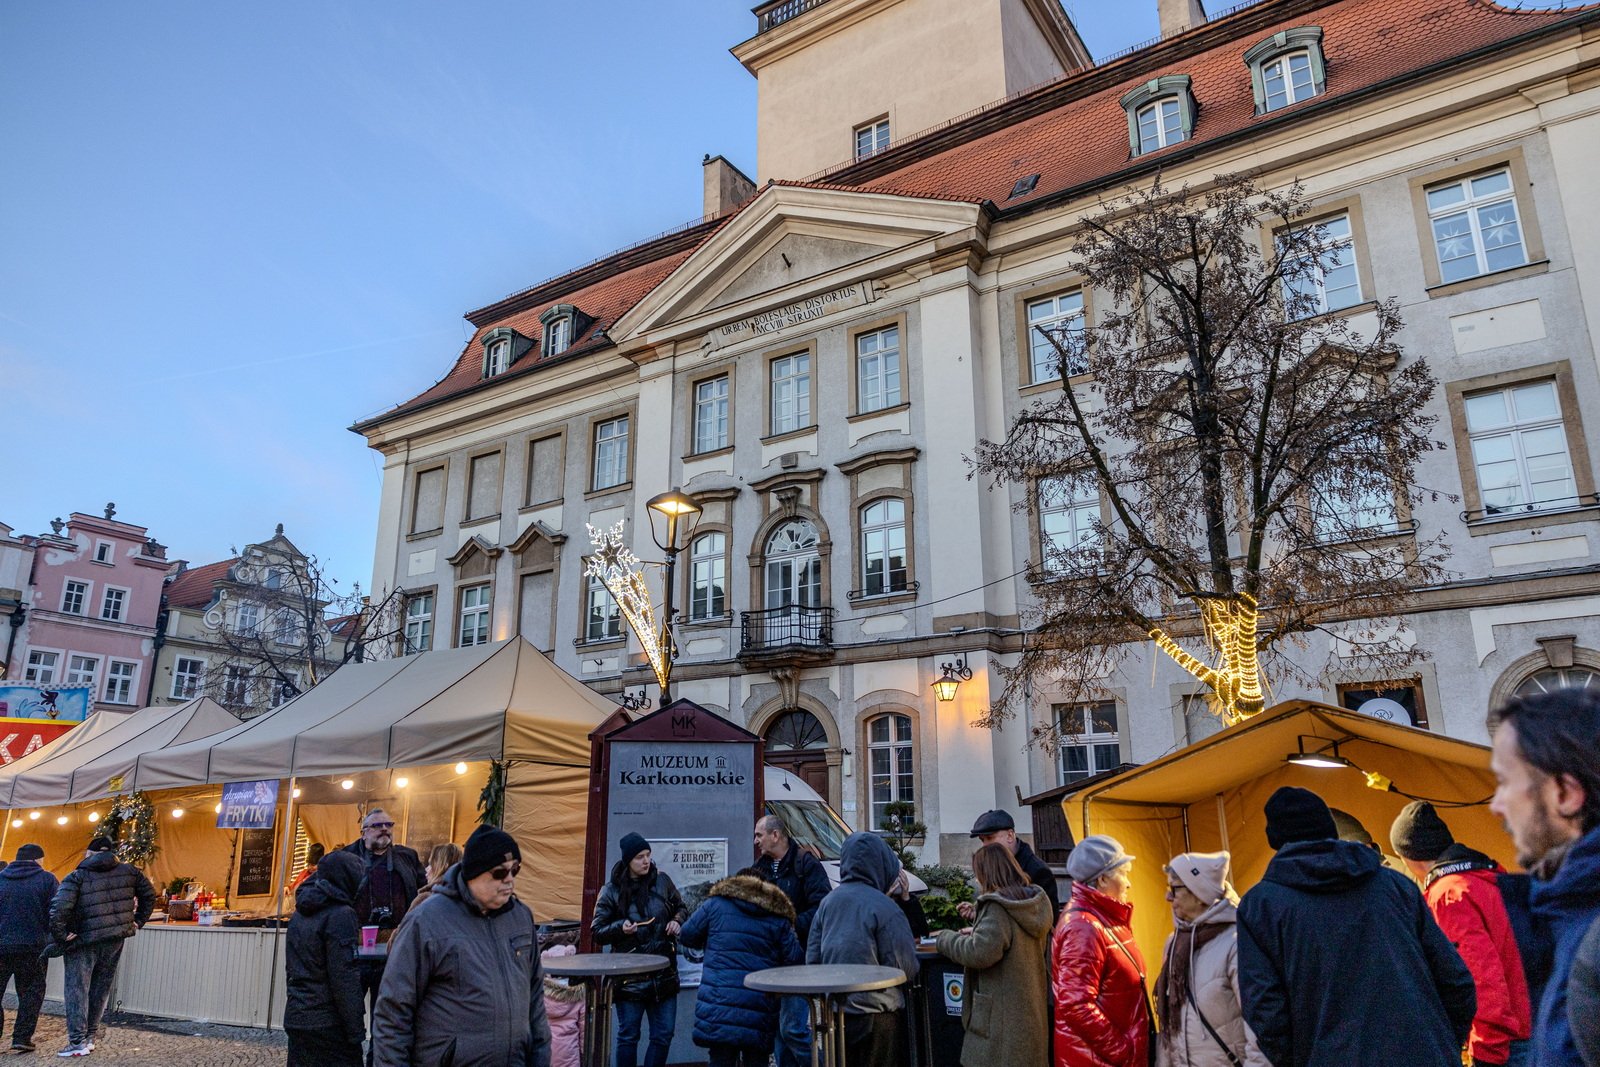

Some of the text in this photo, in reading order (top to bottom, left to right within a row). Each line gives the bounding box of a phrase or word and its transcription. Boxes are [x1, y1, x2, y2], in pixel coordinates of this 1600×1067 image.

[721, 286, 857, 336] URBEM BOLESLAUS DISTORTUS
[755, 306, 824, 335] MCVIII STRUXIT
[671, 716, 696, 729] MK
[641, 755, 709, 769] MUZEUM
[619, 770, 745, 785] Karkonoskie
[224, 805, 267, 822] FRYTKI
[673, 853, 714, 863] Z EUROPY
